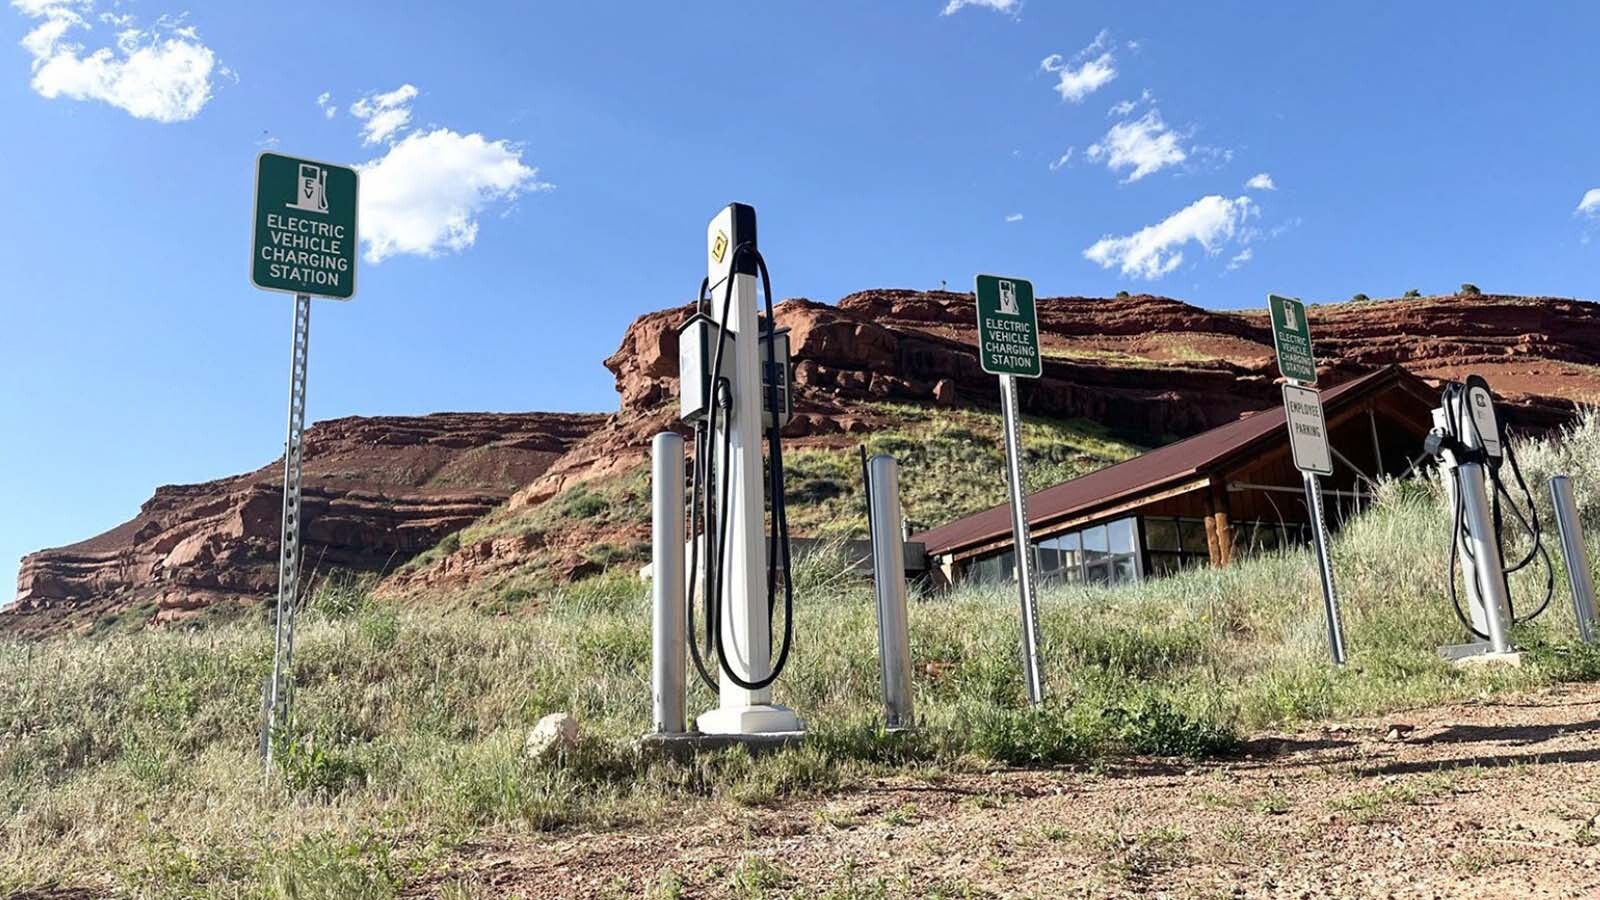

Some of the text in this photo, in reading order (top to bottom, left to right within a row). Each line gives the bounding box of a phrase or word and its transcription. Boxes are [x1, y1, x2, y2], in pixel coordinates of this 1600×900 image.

[267, 214, 344, 239] ELECTRIC
[270, 231, 341, 254] VEHICLE
[261, 246, 348, 271] CHARGING
[270, 264, 339, 286] STATION
[986, 318, 1030, 333] ELECTRIC
[989, 330, 1030, 345] VEHICLE
[1279, 332, 1306, 346] ELECTRIC
[985, 342, 1035, 357] CHARGING
[1282, 343, 1307, 356] VEHICLE
[991, 354, 1031, 368] STATION
[1281, 352, 1311, 366] CHARGING
[1286, 362, 1311, 375] STATION
[1290, 402, 1320, 417] EMPLOYEE
[1295, 422, 1320, 437] PARKING
